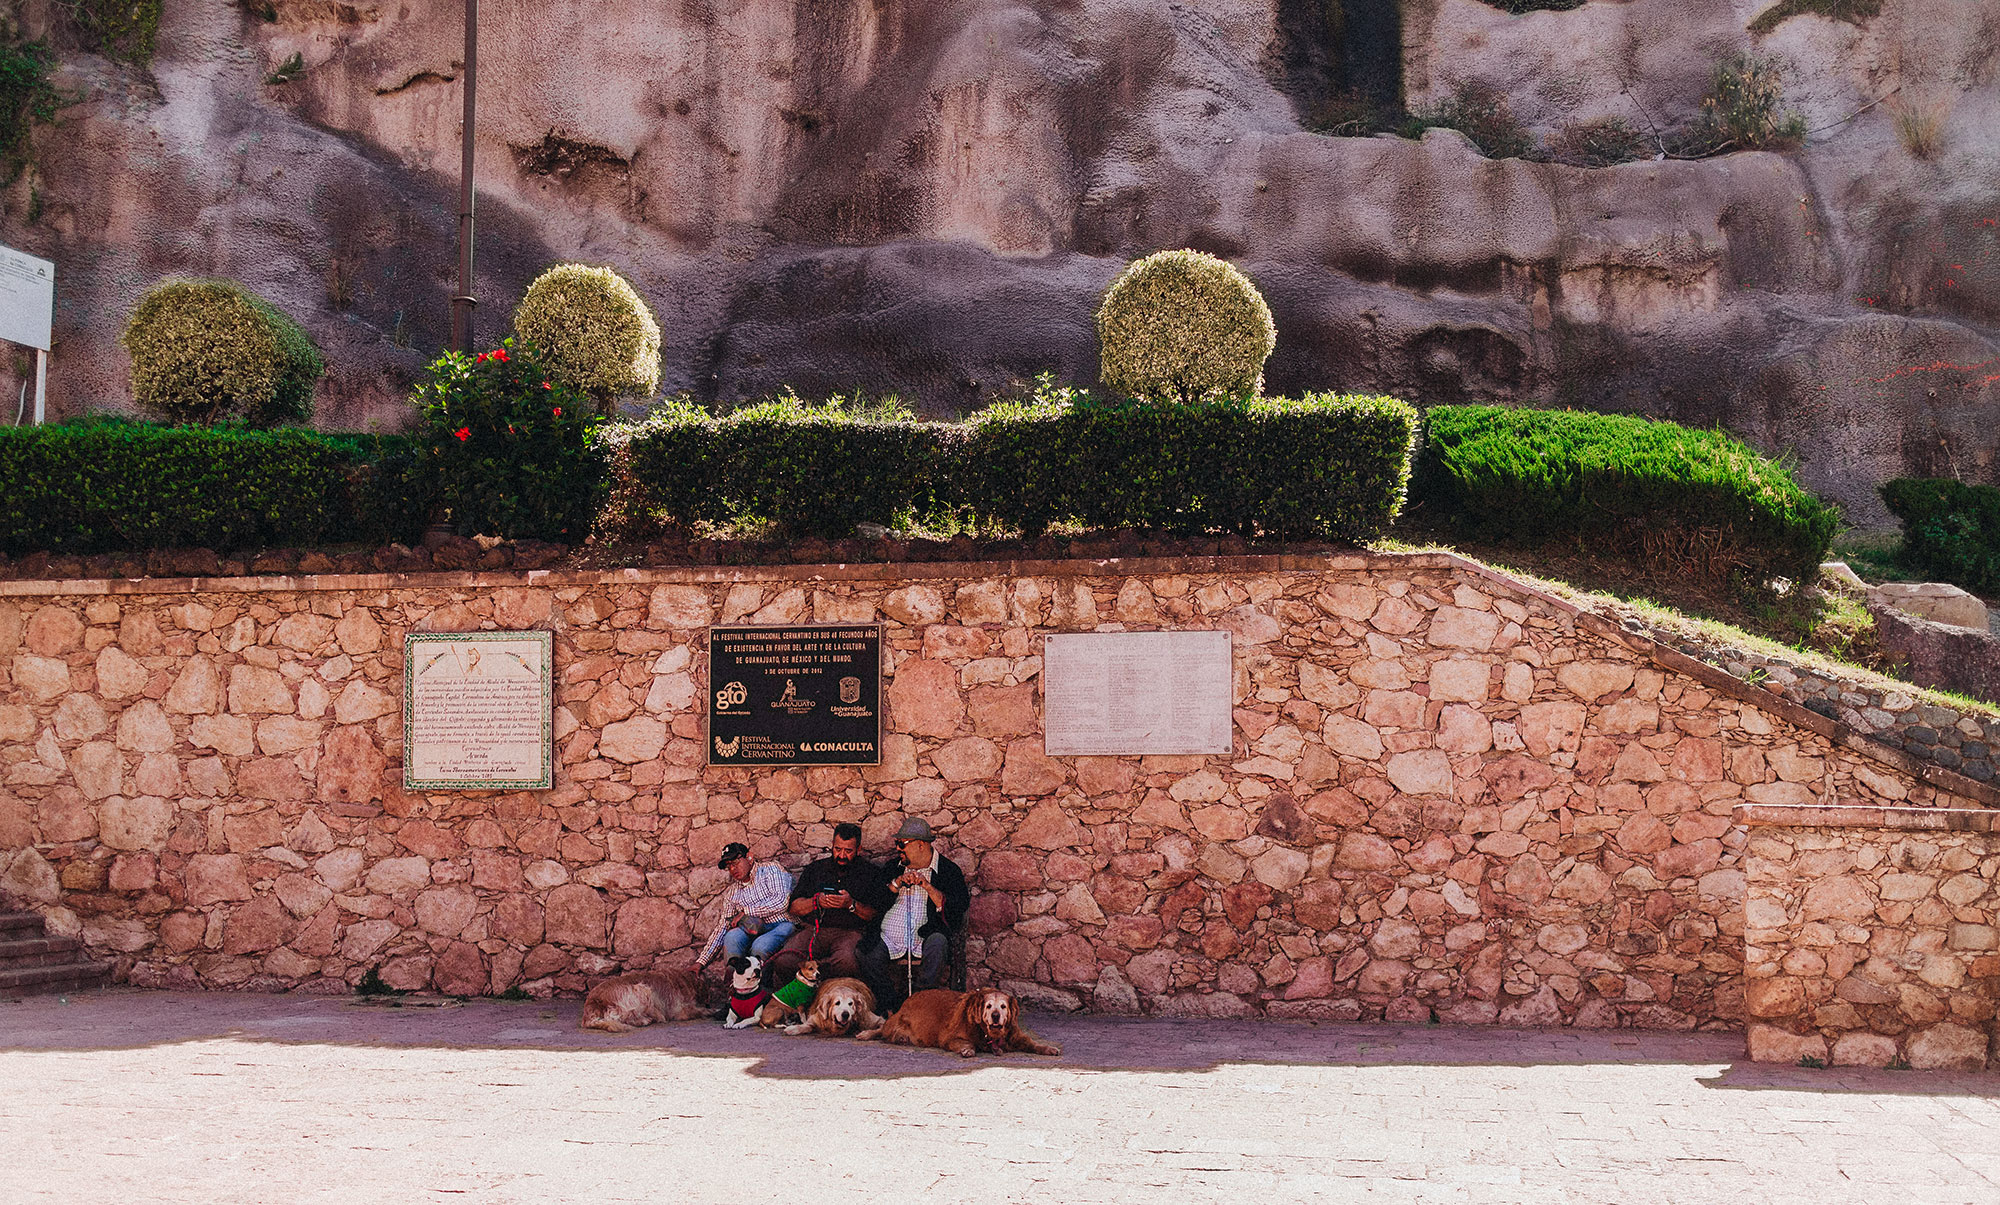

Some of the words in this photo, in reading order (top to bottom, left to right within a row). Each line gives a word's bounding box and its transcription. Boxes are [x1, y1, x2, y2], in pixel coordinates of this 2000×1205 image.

[865, 630, 877, 638] AÑOS
[791, 655, 811, 663] MÉXICO
[716, 687, 746, 709] gto
[814, 742, 873, 751] CONACULTA
[742, 750, 795, 758] CERVANTINO
